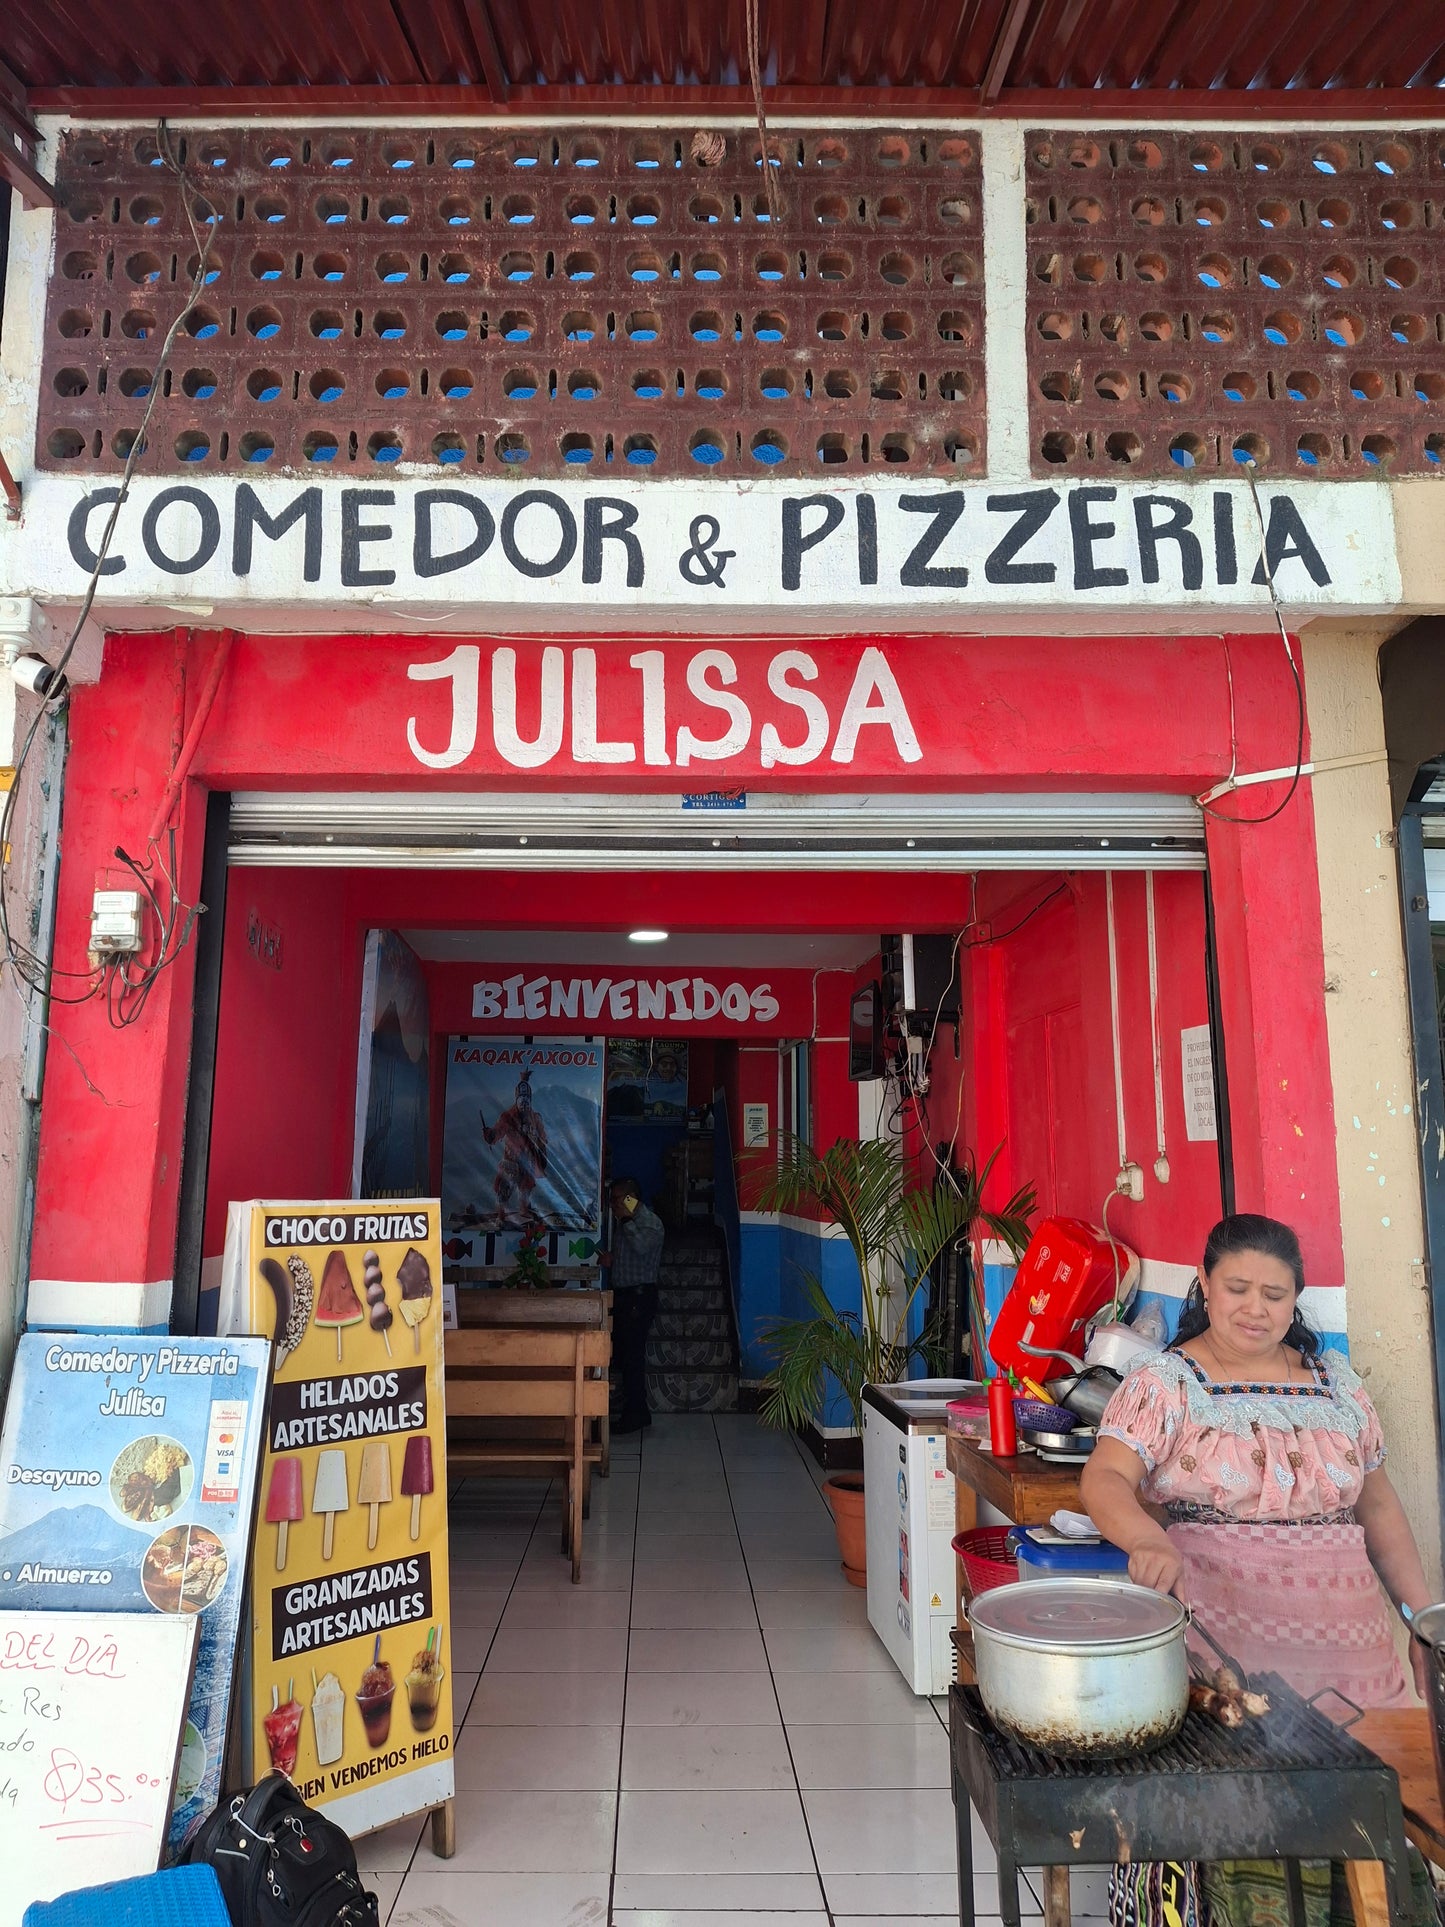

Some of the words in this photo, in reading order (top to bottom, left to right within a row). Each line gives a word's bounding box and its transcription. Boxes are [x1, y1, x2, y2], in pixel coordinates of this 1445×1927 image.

[67, 483, 644, 587] COMEDOR
[679, 514, 736, 586] &
[781, 486, 1332, 591] PIZZERIA
[406, 645, 924, 769] JULISSA
[472, 974, 780, 1022] BIENVENIDOS
[266, 1218, 347, 1244] CHOCO
[353, 1215, 427, 1241] FRUTAS
[45, 1345, 141, 1374] Comedor
[139, 1354, 154, 1382] y
[156, 1348, 240, 1375] Pizzeria
[100, 1387, 166, 1417] Jullisa
[300, 1372, 399, 1410] HELADOS
[273, 1401, 424, 1449] ARTESANALES
[217, 1449, 235, 1457] VISA
[7, 1464, 102, 1491] Desayuno
[16, 1562, 113, 1586] Almuerzo
[285, 1559, 419, 1615] GRANIZADAS
[281, 1592, 425, 1654] ARTESANALES
[5, 1631, 55, 1661] DEL
[23, 1687, 61, 1721] Res
[330, 1748, 407, 1790] VENDEMOS
[411, 1734, 449, 1760] HIELO
